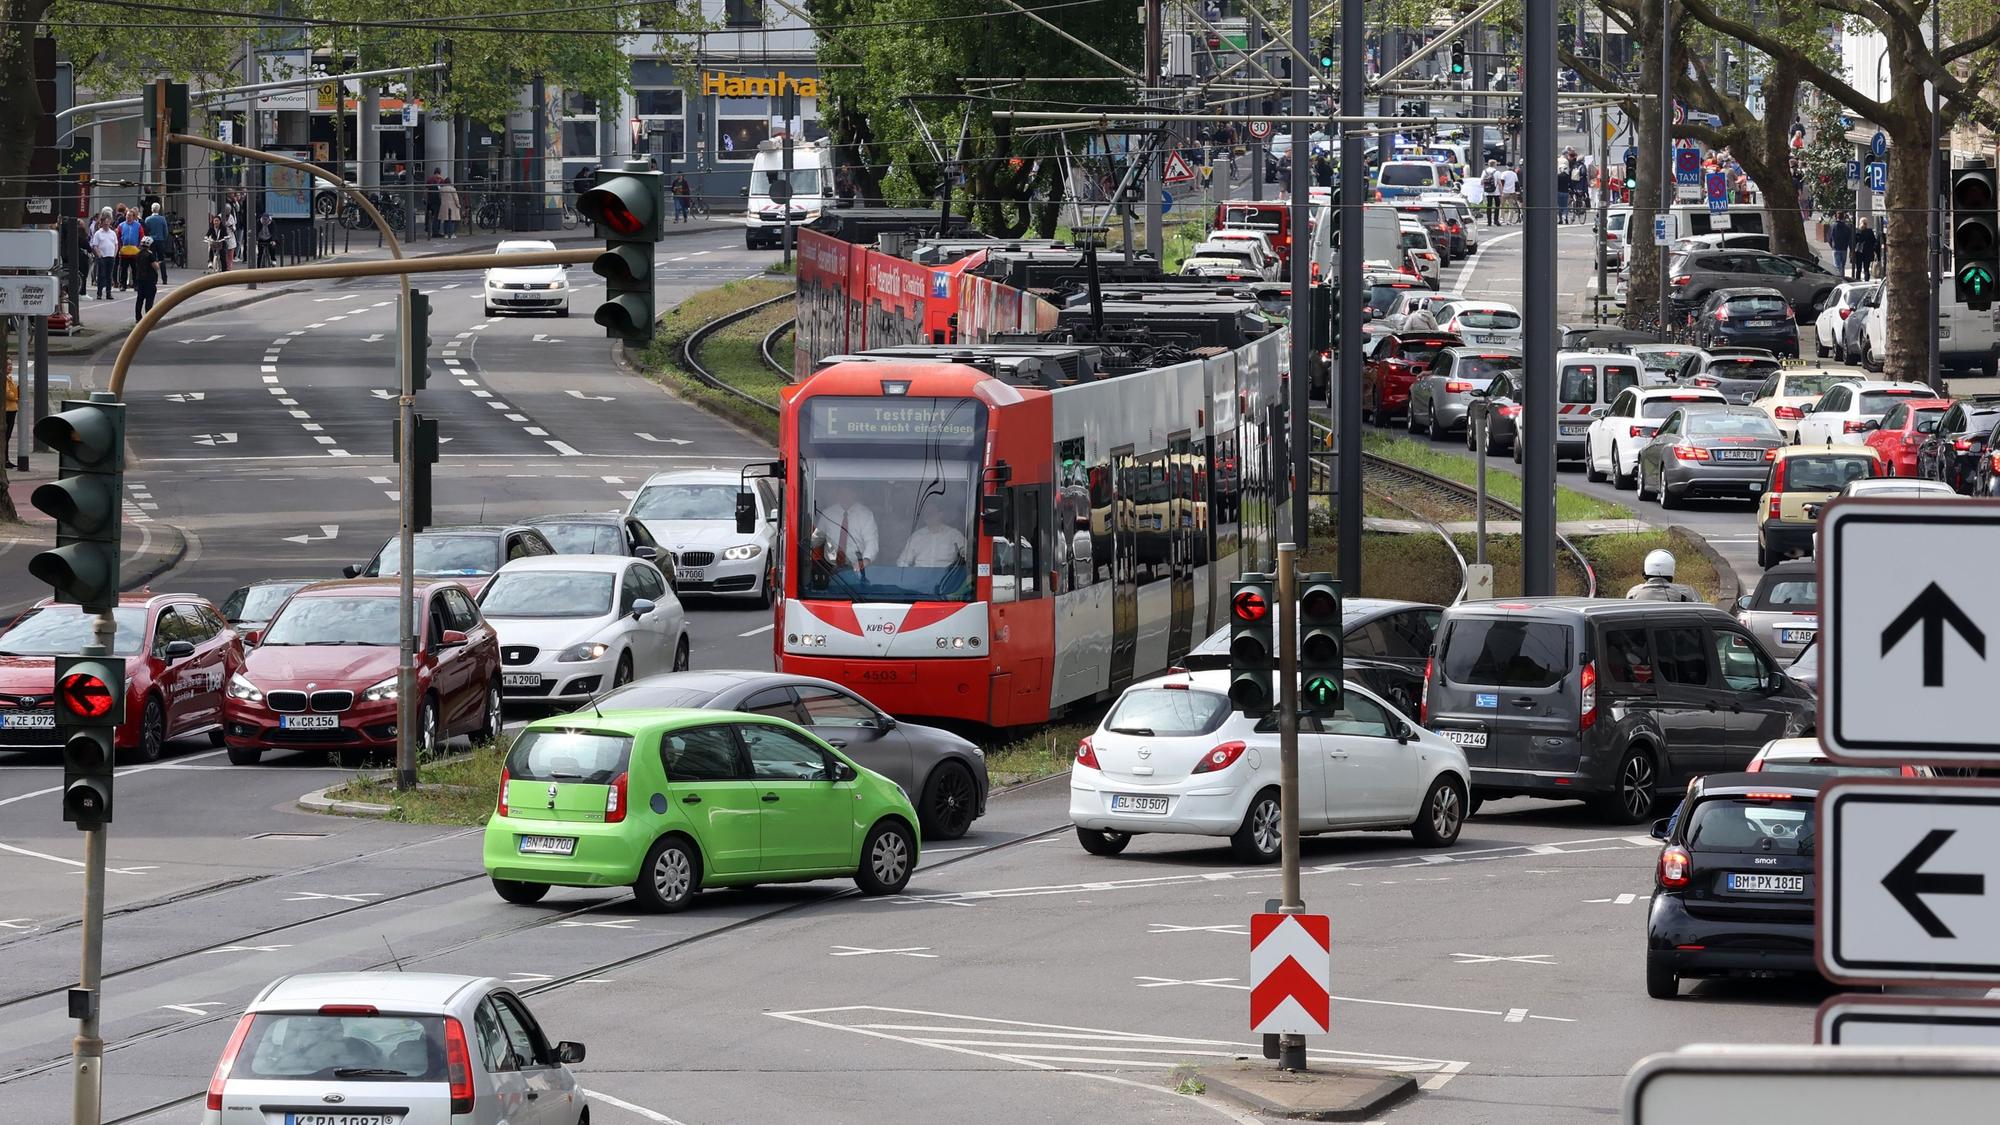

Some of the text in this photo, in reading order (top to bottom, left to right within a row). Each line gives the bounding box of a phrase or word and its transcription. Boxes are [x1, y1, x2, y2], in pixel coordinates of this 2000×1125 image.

[702, 71, 829, 97] Hamba
[1254, 122, 1266, 131] 30
[1849, 163, 1857, 177] P
[1678, 173, 1698, 182] TAXI
[1874, 166, 1883, 187] P
[1711, 201, 1728, 210] TAXI
[827, 407, 838, 434] E
[874, 408, 946, 422] Testfahrt
[847, 422, 974, 434] Bitte nicht einsteigen
[866, 624, 883, 632] KVB
[1787, 631, 1812, 641] K AB
[206, 671, 223, 693] Uber
[519, 676, 539, 685] 2900
[4, 716, 55, 726] K ZE 1972
[289, 716, 334, 727] K CR 156
[1463, 733, 1486, 745] 2146
[1117, 797, 1167, 810] GL SD 507
[525, 836, 572, 850] BN AD 700
[1754, 857, 1777, 865] smart
[1735, 875, 1802, 890] BM PX 181E
